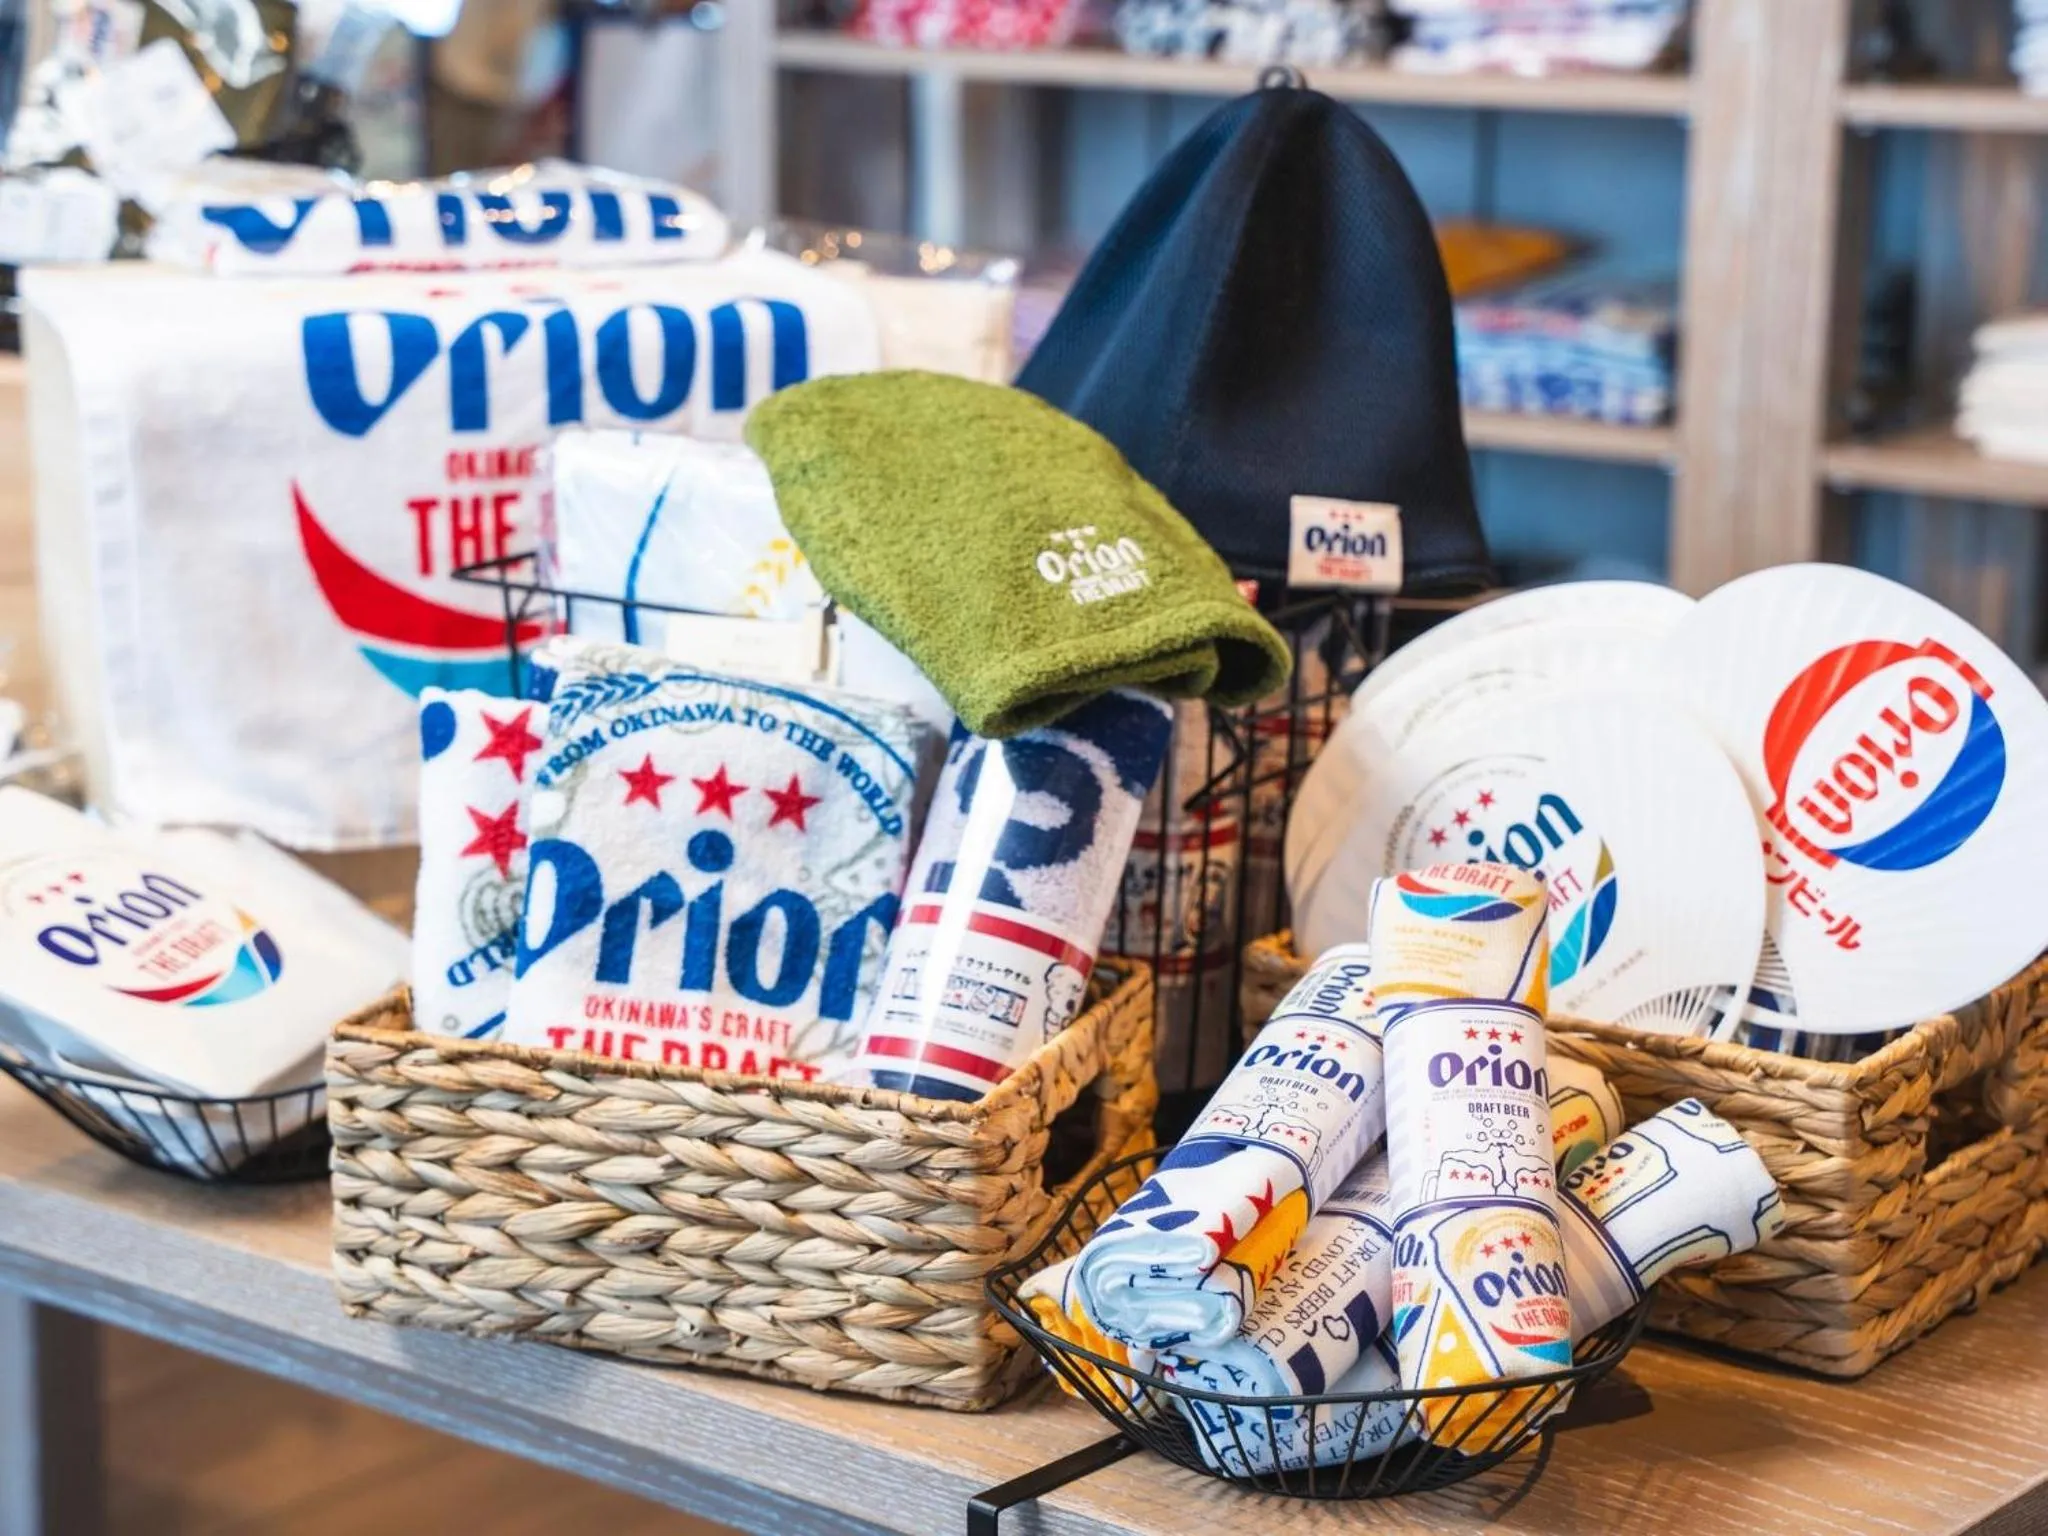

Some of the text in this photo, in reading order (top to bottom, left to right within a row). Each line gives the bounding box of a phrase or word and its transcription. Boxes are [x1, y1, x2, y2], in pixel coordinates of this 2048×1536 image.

[407, 490, 520, 576] THE
[1305, 524, 1386, 558] Orion
[1037, 537, 1145, 582] Orion
[535, 703, 903, 837] FROM OKINAWA TO THE WORLD
[1798, 676, 1959, 834] Orion
[1452, 864, 1515, 895] DRAFT
[37, 874, 202, 966] Orion
[584, 995, 793, 1048] OKINAWA'S CRAFT
[1244, 1044, 1365, 1103] Orion
[1260, 1075, 1318, 1096] DRAFT BEER
[1428, 1044, 1549, 1104] Orion
[1468, 1102, 1530, 1119] DRAFT BEER
[1302, 1235, 1352, 1280] LOVED
[1332, 1238, 1381, 1288] DRAFT
[1473, 1251, 1569, 1308] Orion
[1280, 1278, 1304, 1298] AS
